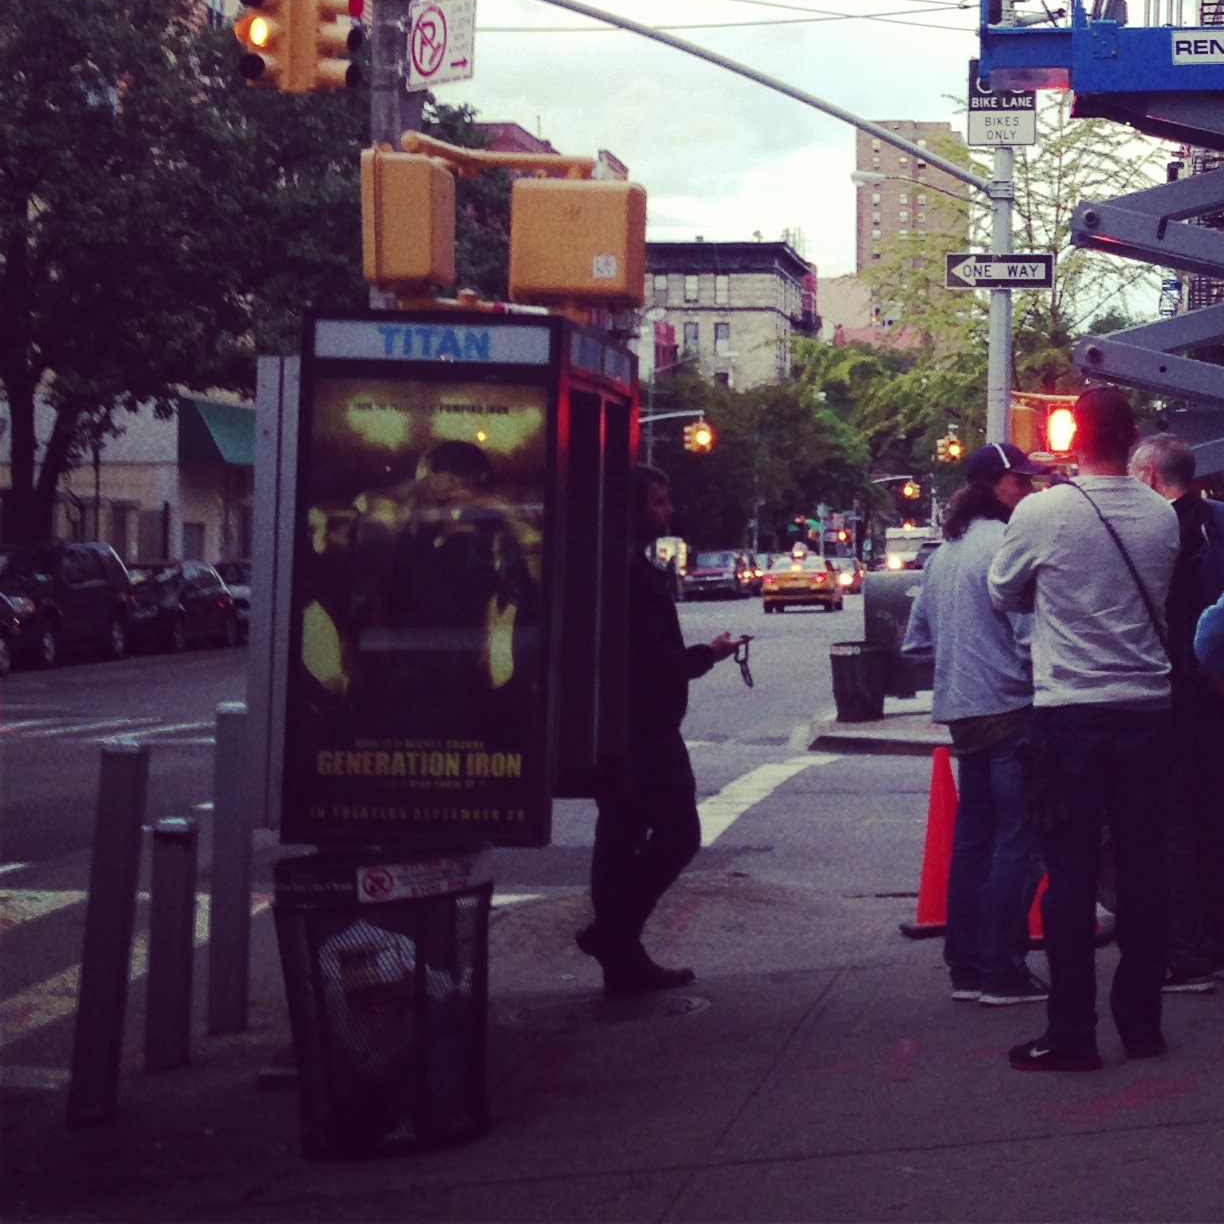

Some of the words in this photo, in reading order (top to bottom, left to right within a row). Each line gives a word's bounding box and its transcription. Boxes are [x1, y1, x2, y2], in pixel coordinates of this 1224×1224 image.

[971, 97, 998, 108] BIKE
[1002, 97, 1033, 108] LANE
[985, 117, 1020, 127] BIKES
[986, 130, 1017, 140] ONLY
[963, 264, 992, 278] ONE
[1007, 264, 1039, 277] WAY
[378, 327, 490, 361] TITAN
[317, 750, 461, 776] GENERATION
[467, 752, 522, 777] IRON
